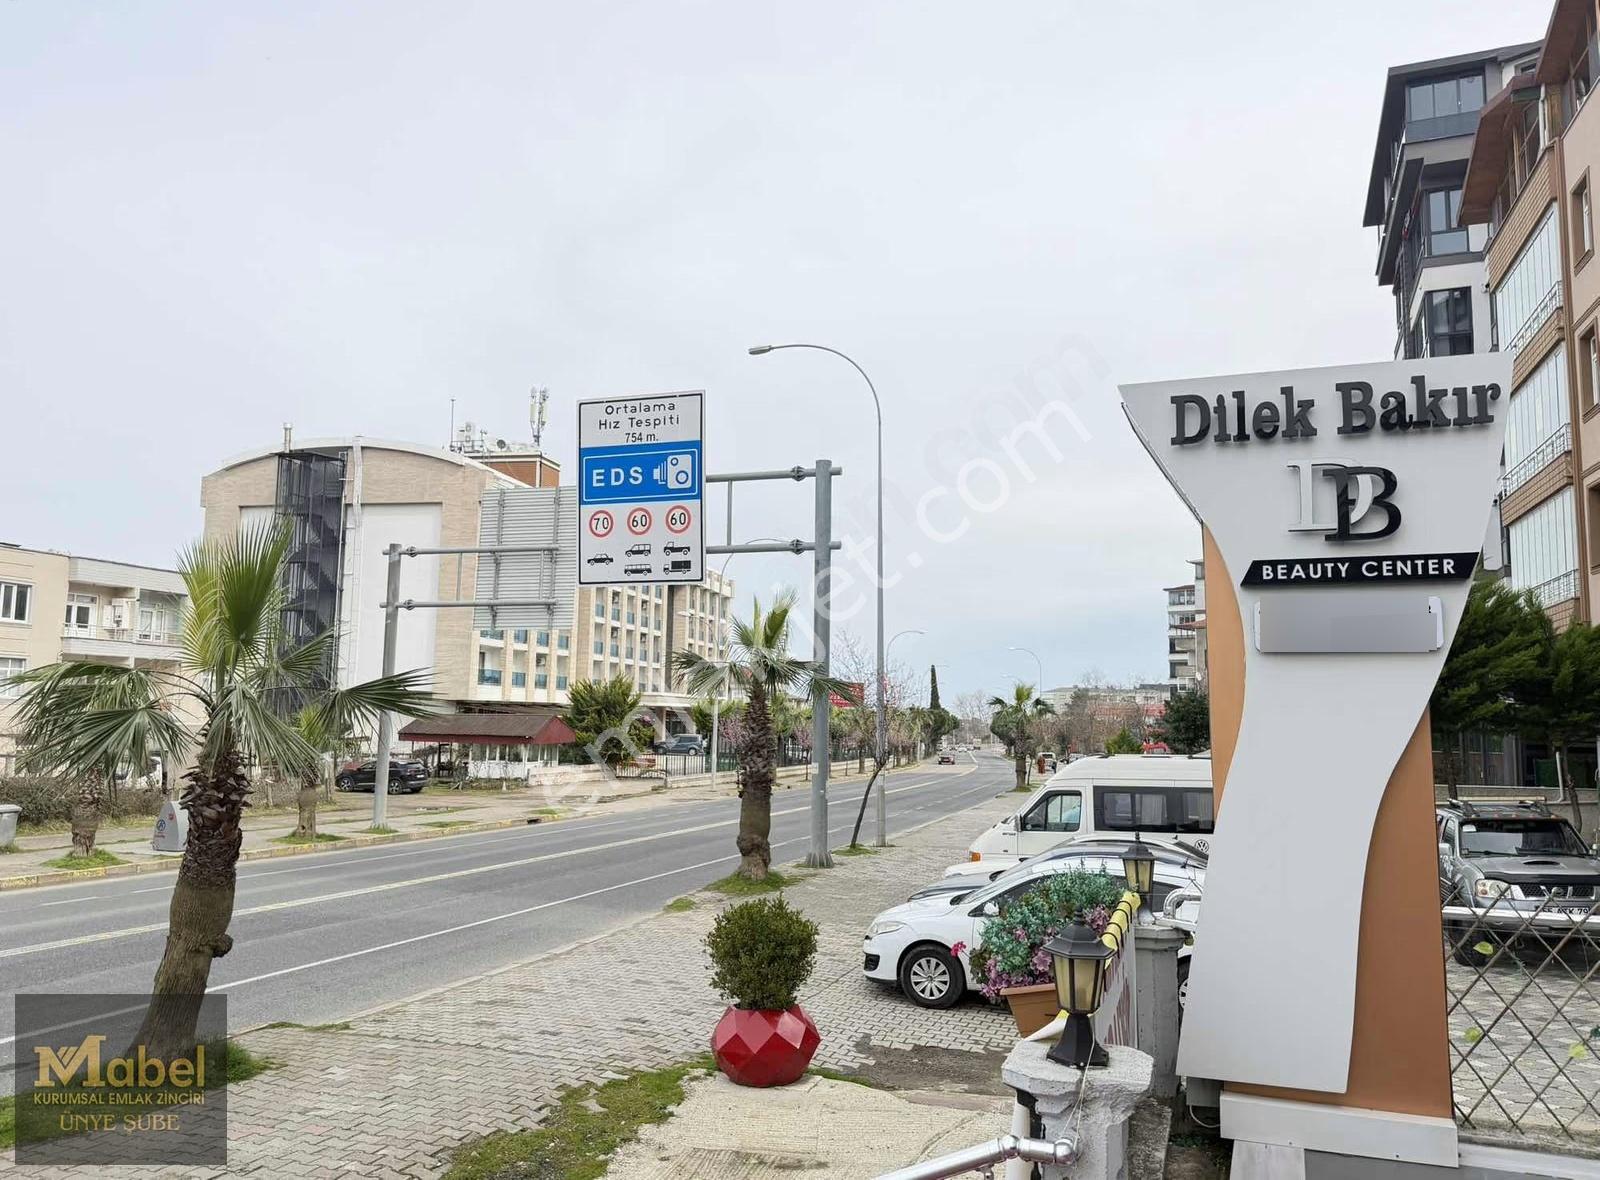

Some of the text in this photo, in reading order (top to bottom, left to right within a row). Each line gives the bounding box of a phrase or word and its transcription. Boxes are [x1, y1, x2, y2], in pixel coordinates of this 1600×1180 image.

[605, 402, 676, 415] Ortalama
[1170, 375, 1502, 446] Dilek Bakır
[599, 414, 680, 430] Hız Tespiti
[625, 431, 659, 443] 754 m.
[592, 466, 643, 487] EDS
[594, 512, 687, 531] 70 60 60
[1262, 558, 1456, 580] BEAUTY CENTER
